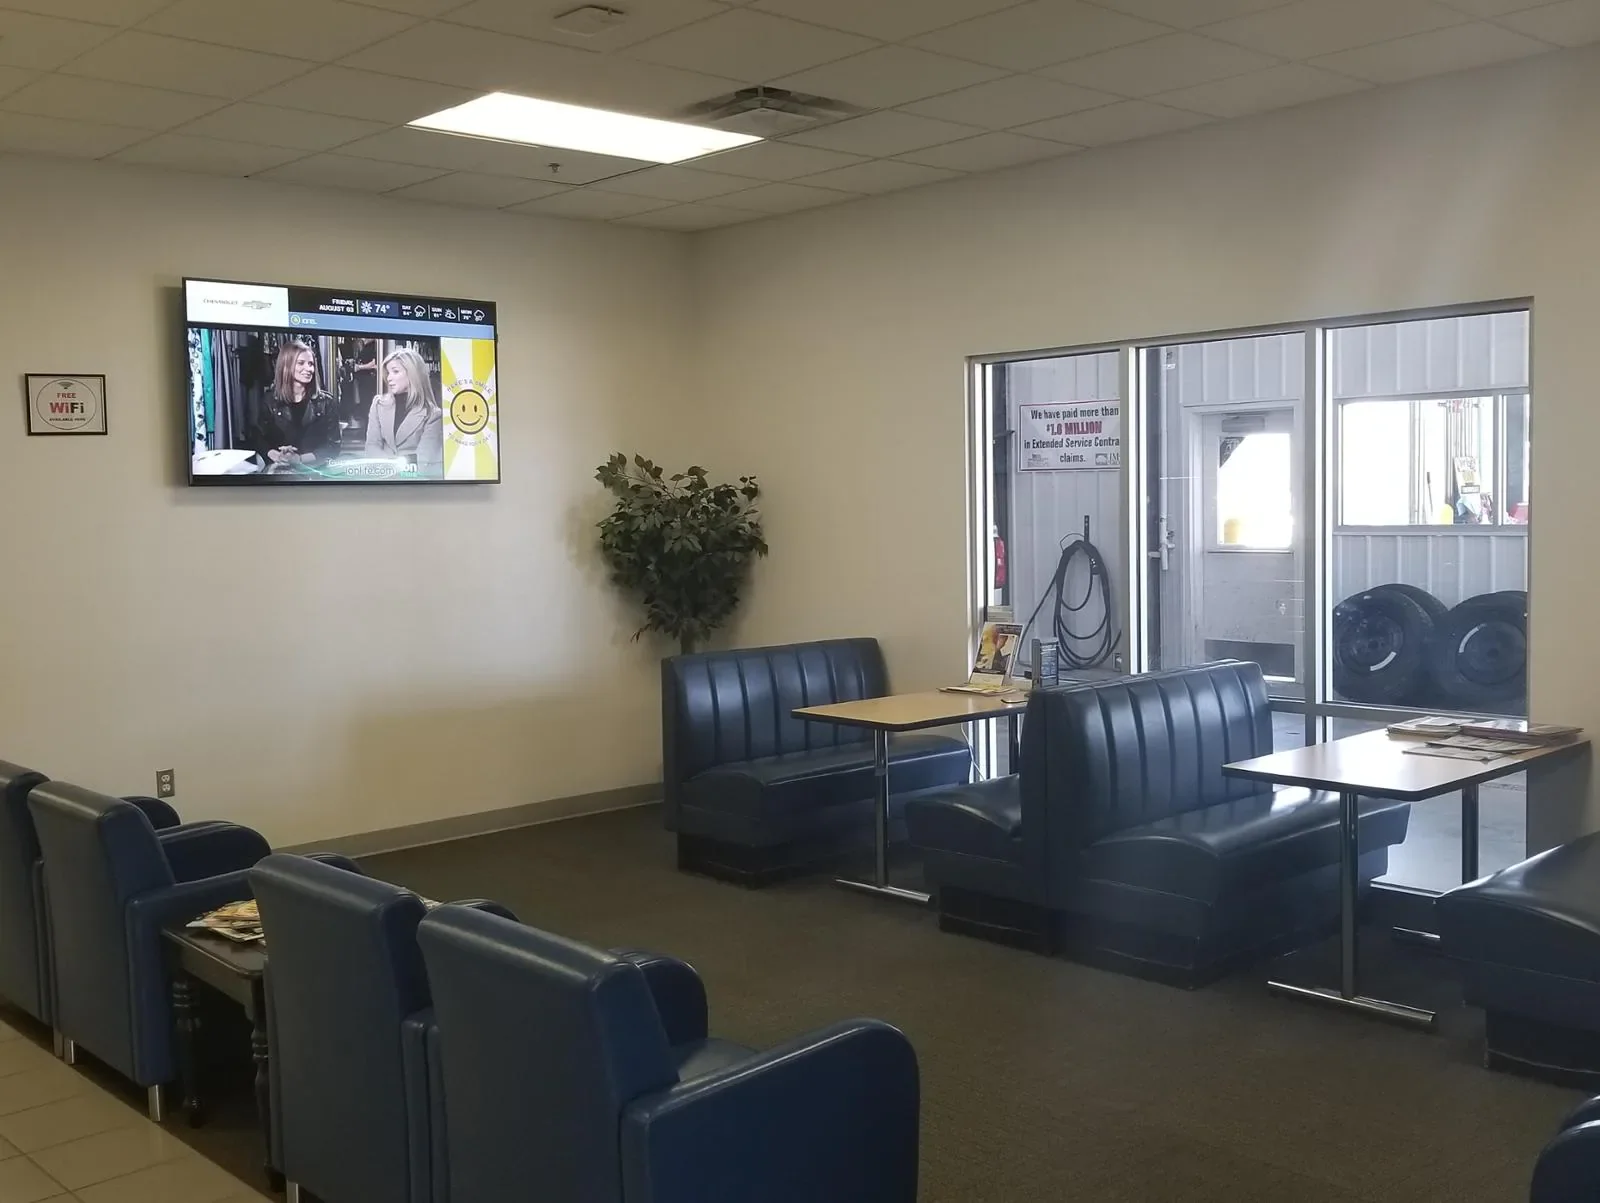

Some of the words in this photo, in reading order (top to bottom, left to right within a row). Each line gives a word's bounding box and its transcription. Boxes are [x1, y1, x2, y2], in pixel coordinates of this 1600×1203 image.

[319, 304, 345, 312] AUGUST
[49, 402, 84, 414] WiFi
[1030, 409, 1043, 420] We
[1044, 409, 1060, 419] have
[1062, 408, 1078, 420] paid
[1080, 408, 1099, 417] more
[1101, 406, 1119, 417] than
[1064, 421, 1103, 435] MILLION
[1024, 439, 1031, 449] in
[1032, 438, 1064, 448] Extended
[1065, 437, 1093, 448] Service
[1059, 452, 1086, 463] claims.
